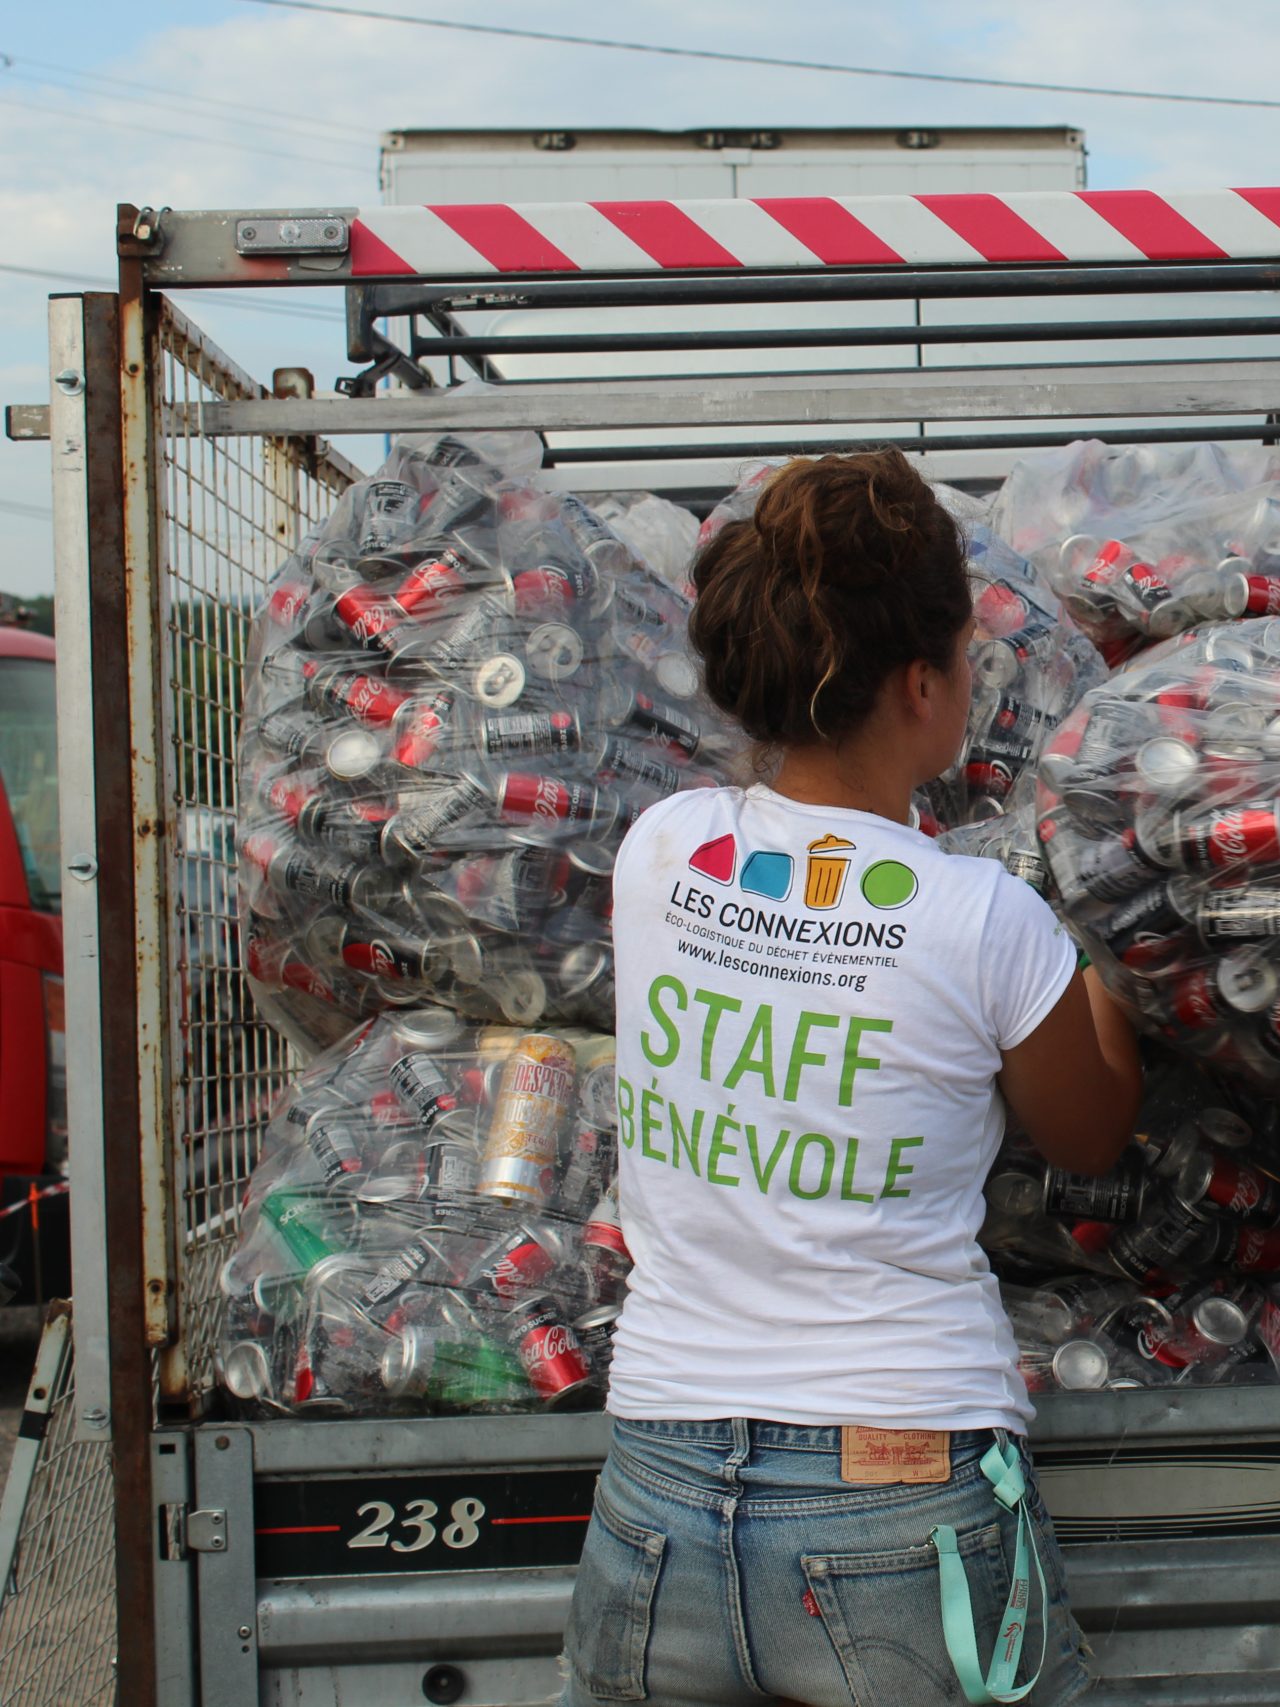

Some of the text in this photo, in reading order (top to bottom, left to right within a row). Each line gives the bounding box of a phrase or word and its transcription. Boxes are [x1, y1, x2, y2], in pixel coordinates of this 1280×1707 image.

[665, 910, 746, 950] ÉCO-LOGISTIQUE
[748, 942, 764, 954] DU
[766, 945, 809, 961] DÉCHET
[670, 880, 907, 950] LES CONNEXIONS
[677, 939, 868, 993] www.lesconnexions.org
[640, 974, 894, 1107] STAFF
[617, 1075, 925, 1204] BÉNÉVOLE
[346, 1496, 486, 1553] 238
